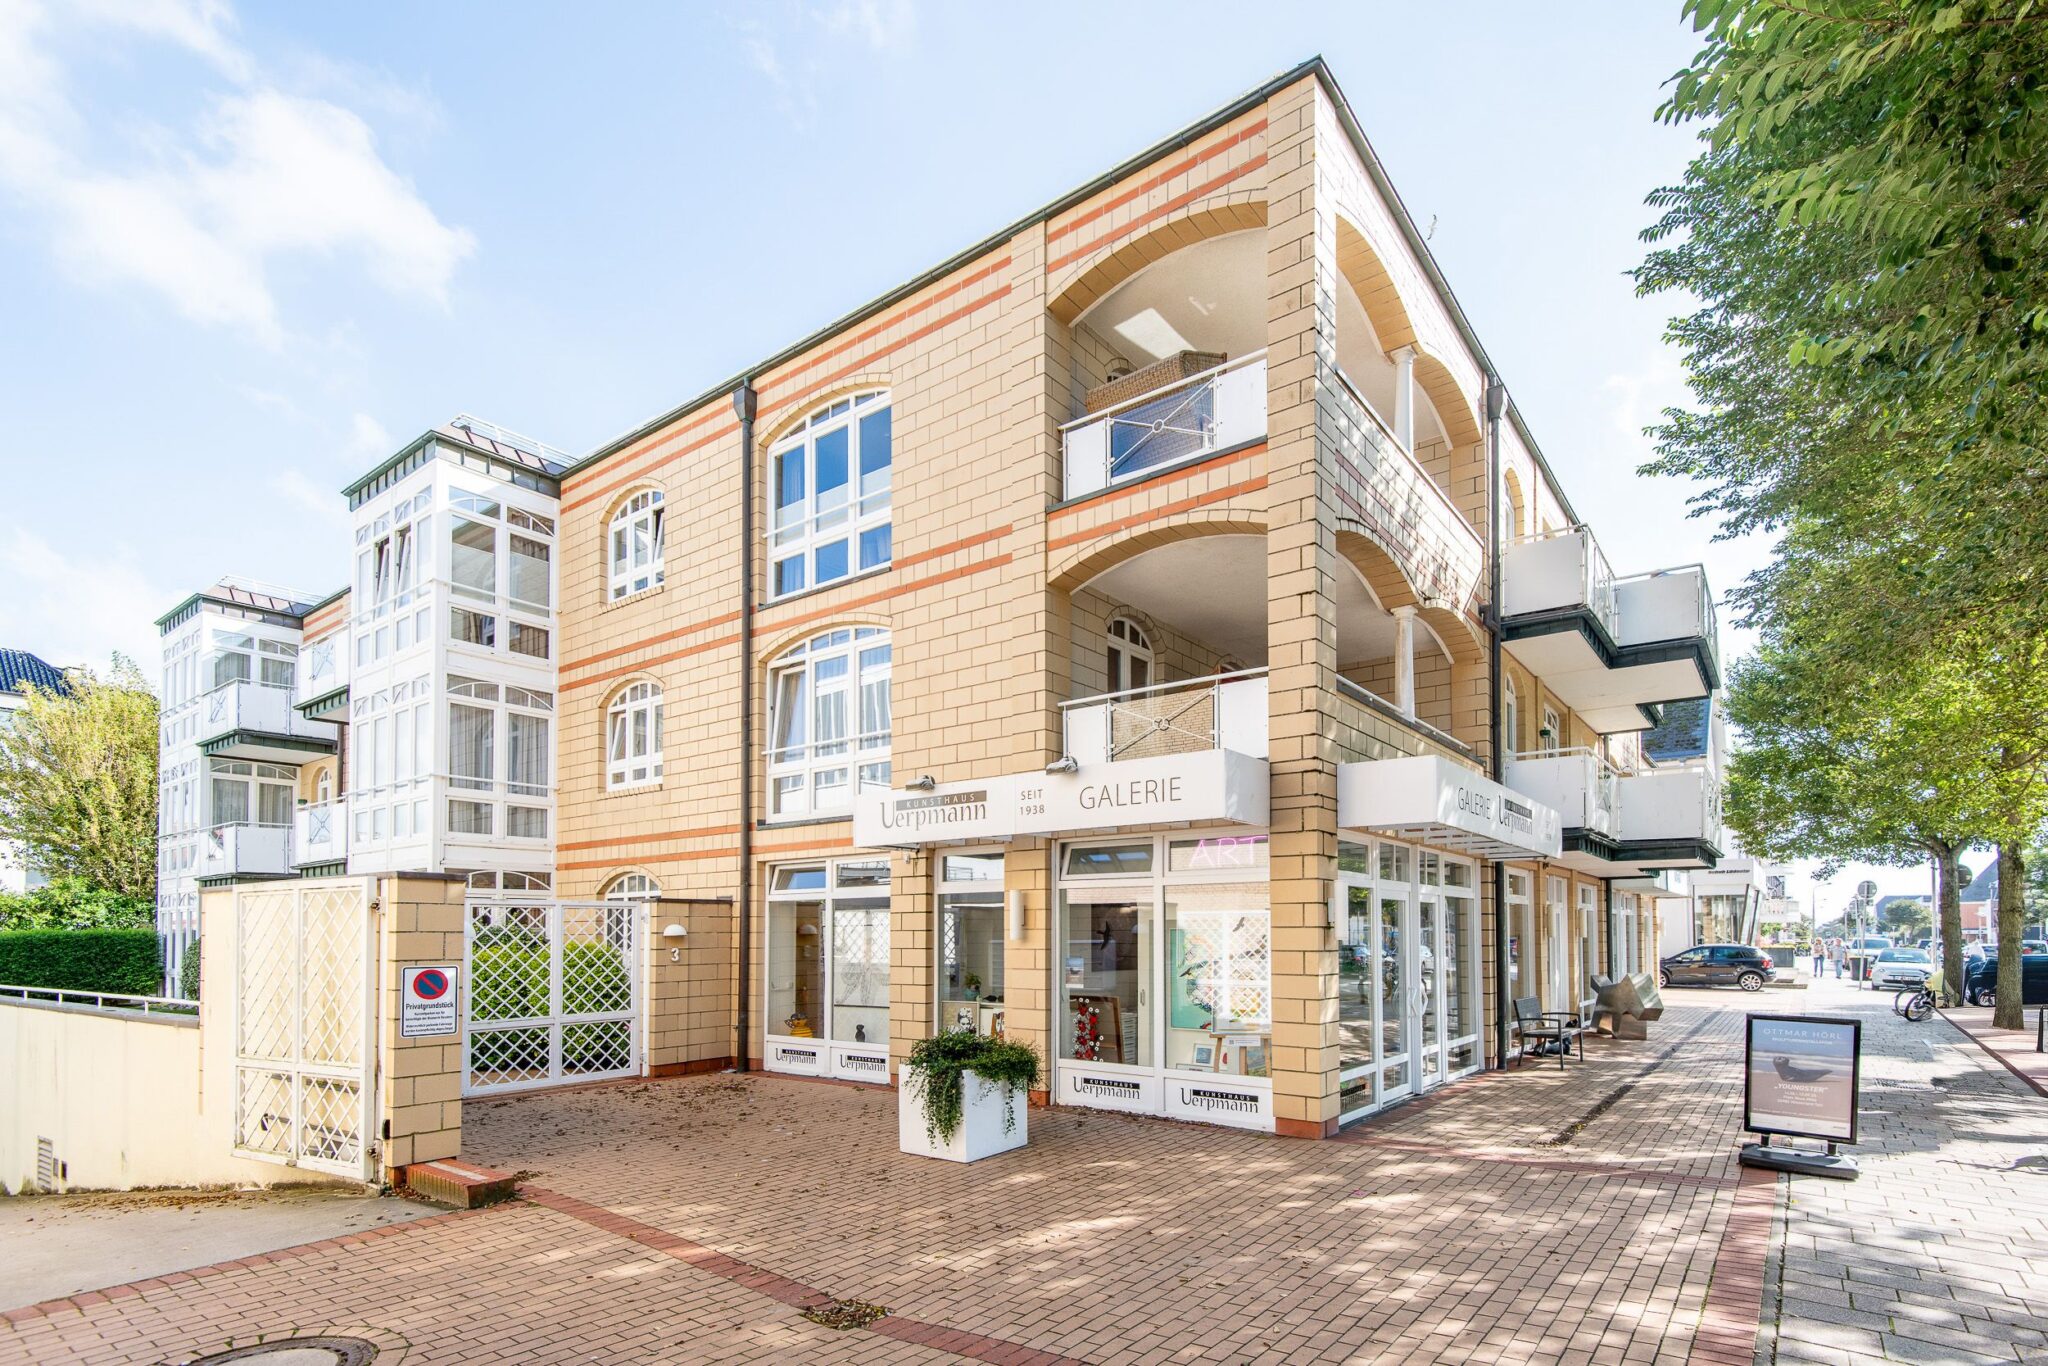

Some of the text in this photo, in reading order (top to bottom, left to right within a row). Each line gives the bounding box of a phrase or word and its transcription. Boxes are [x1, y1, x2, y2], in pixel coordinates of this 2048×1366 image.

[906, 793, 975, 809] KUNSTHAUS
[1020, 789, 1043, 801] SEIT
[1079, 777, 1182, 809] GALERIE
[1020, 804, 1045, 816] 1938
[1457, 787, 1491, 820] GALERIE
[880, 799, 986, 831] Uerpmann
[1188, 835, 1269, 868] ART
[671, 947, 680, 962] 3
[405, 1002, 454, 1011] Privatgrundstück
[1763, 1028, 1808, 1038] OTTMAR
[775, 1047, 817, 1065] Uerpmann
[840, 1054, 886, 1072] Uerpmann
[1073, 1076, 1140, 1099] Uerpmann
[1089, 1079, 1133, 1089] KUNSTHAUS
[1181, 1087, 1259, 1113] Uerpmann
[1200, 1090, 1251, 1101] KUNSTHAUS
